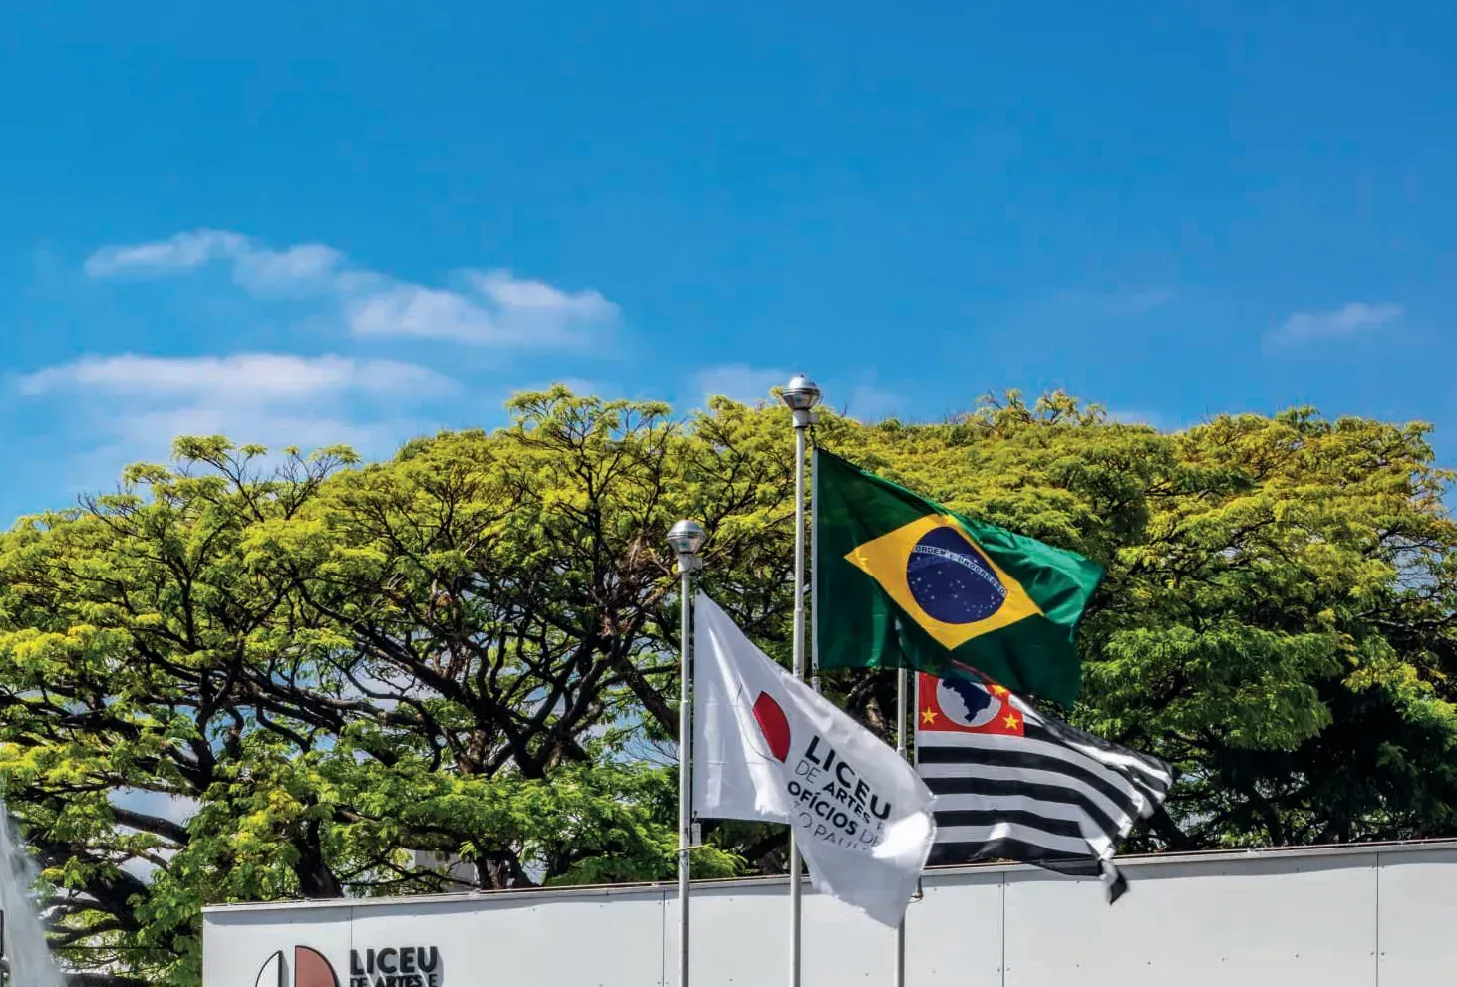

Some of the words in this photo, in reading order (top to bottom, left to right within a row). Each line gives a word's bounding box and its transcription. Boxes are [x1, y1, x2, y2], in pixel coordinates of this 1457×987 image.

[795, 760, 821, 784] DE
[822, 781, 871, 824] ARTES
[805, 735, 892, 820] LICEU
[787, 781, 859, 836] OFÍCIOS
[350, 946, 438, 975] LICEU
[428, 973, 438, 987] E
